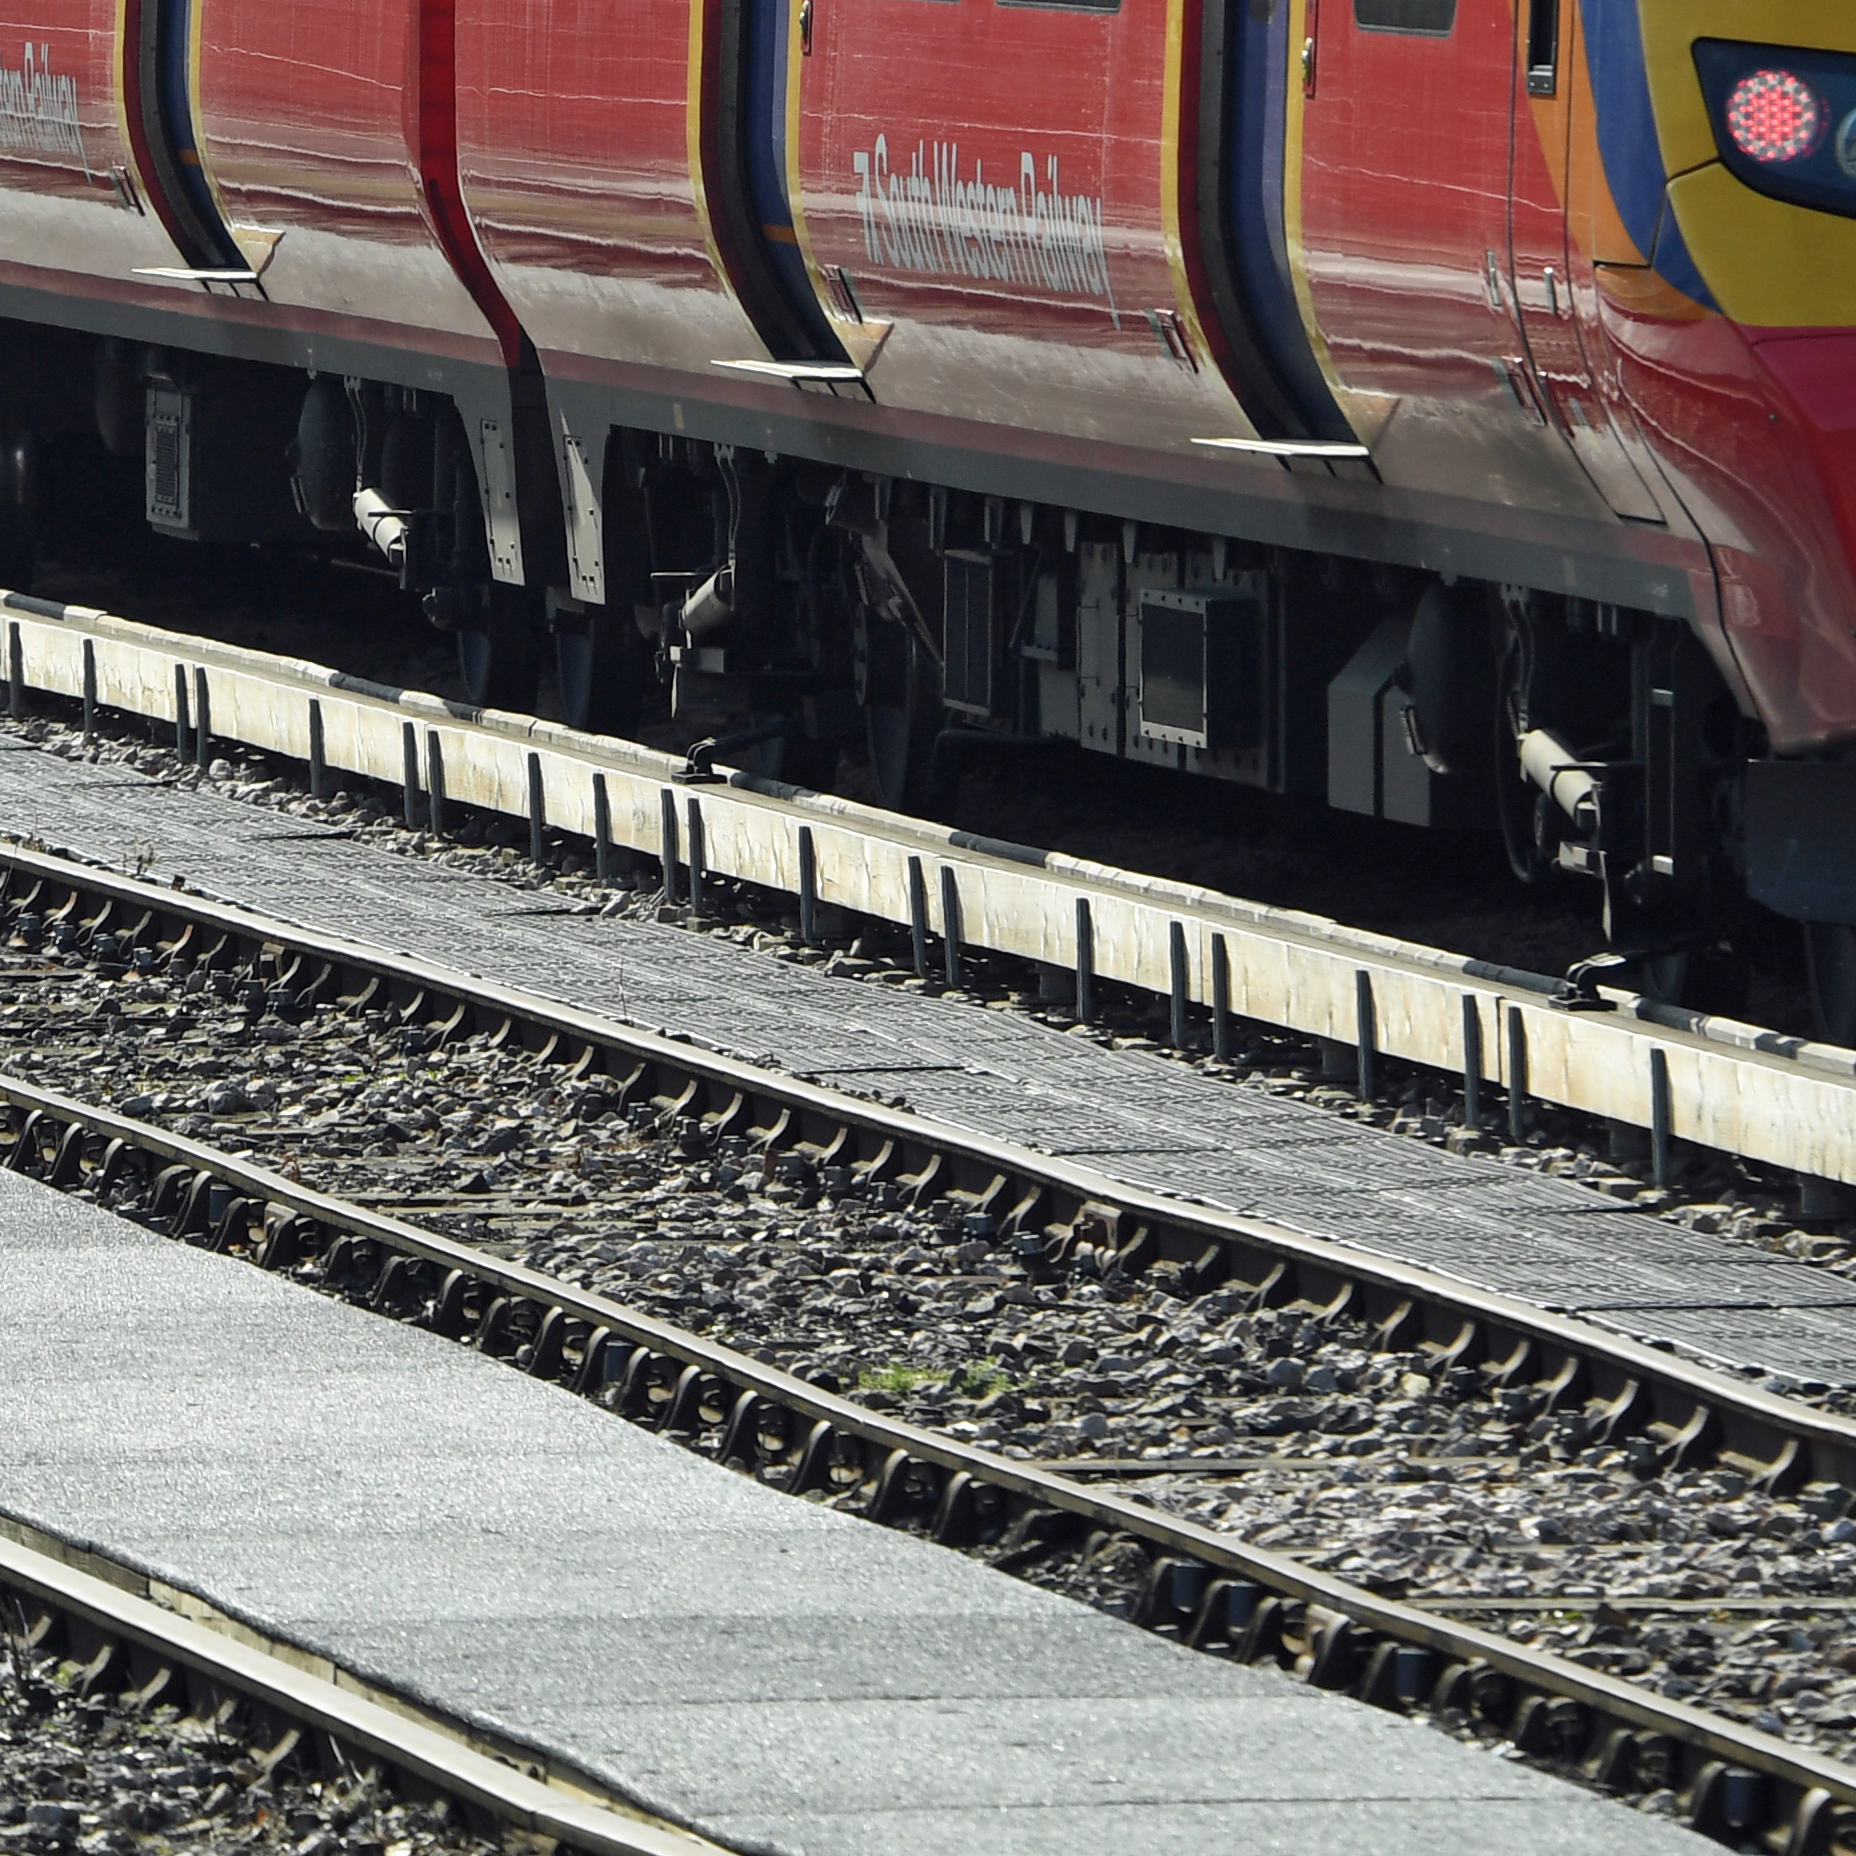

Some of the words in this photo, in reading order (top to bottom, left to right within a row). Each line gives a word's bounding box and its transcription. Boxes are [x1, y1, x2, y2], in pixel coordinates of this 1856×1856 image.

[874, 133, 946, 273] South
[933, 141, 1027, 284] Western
[1020, 152, 1122, 331] Railway
